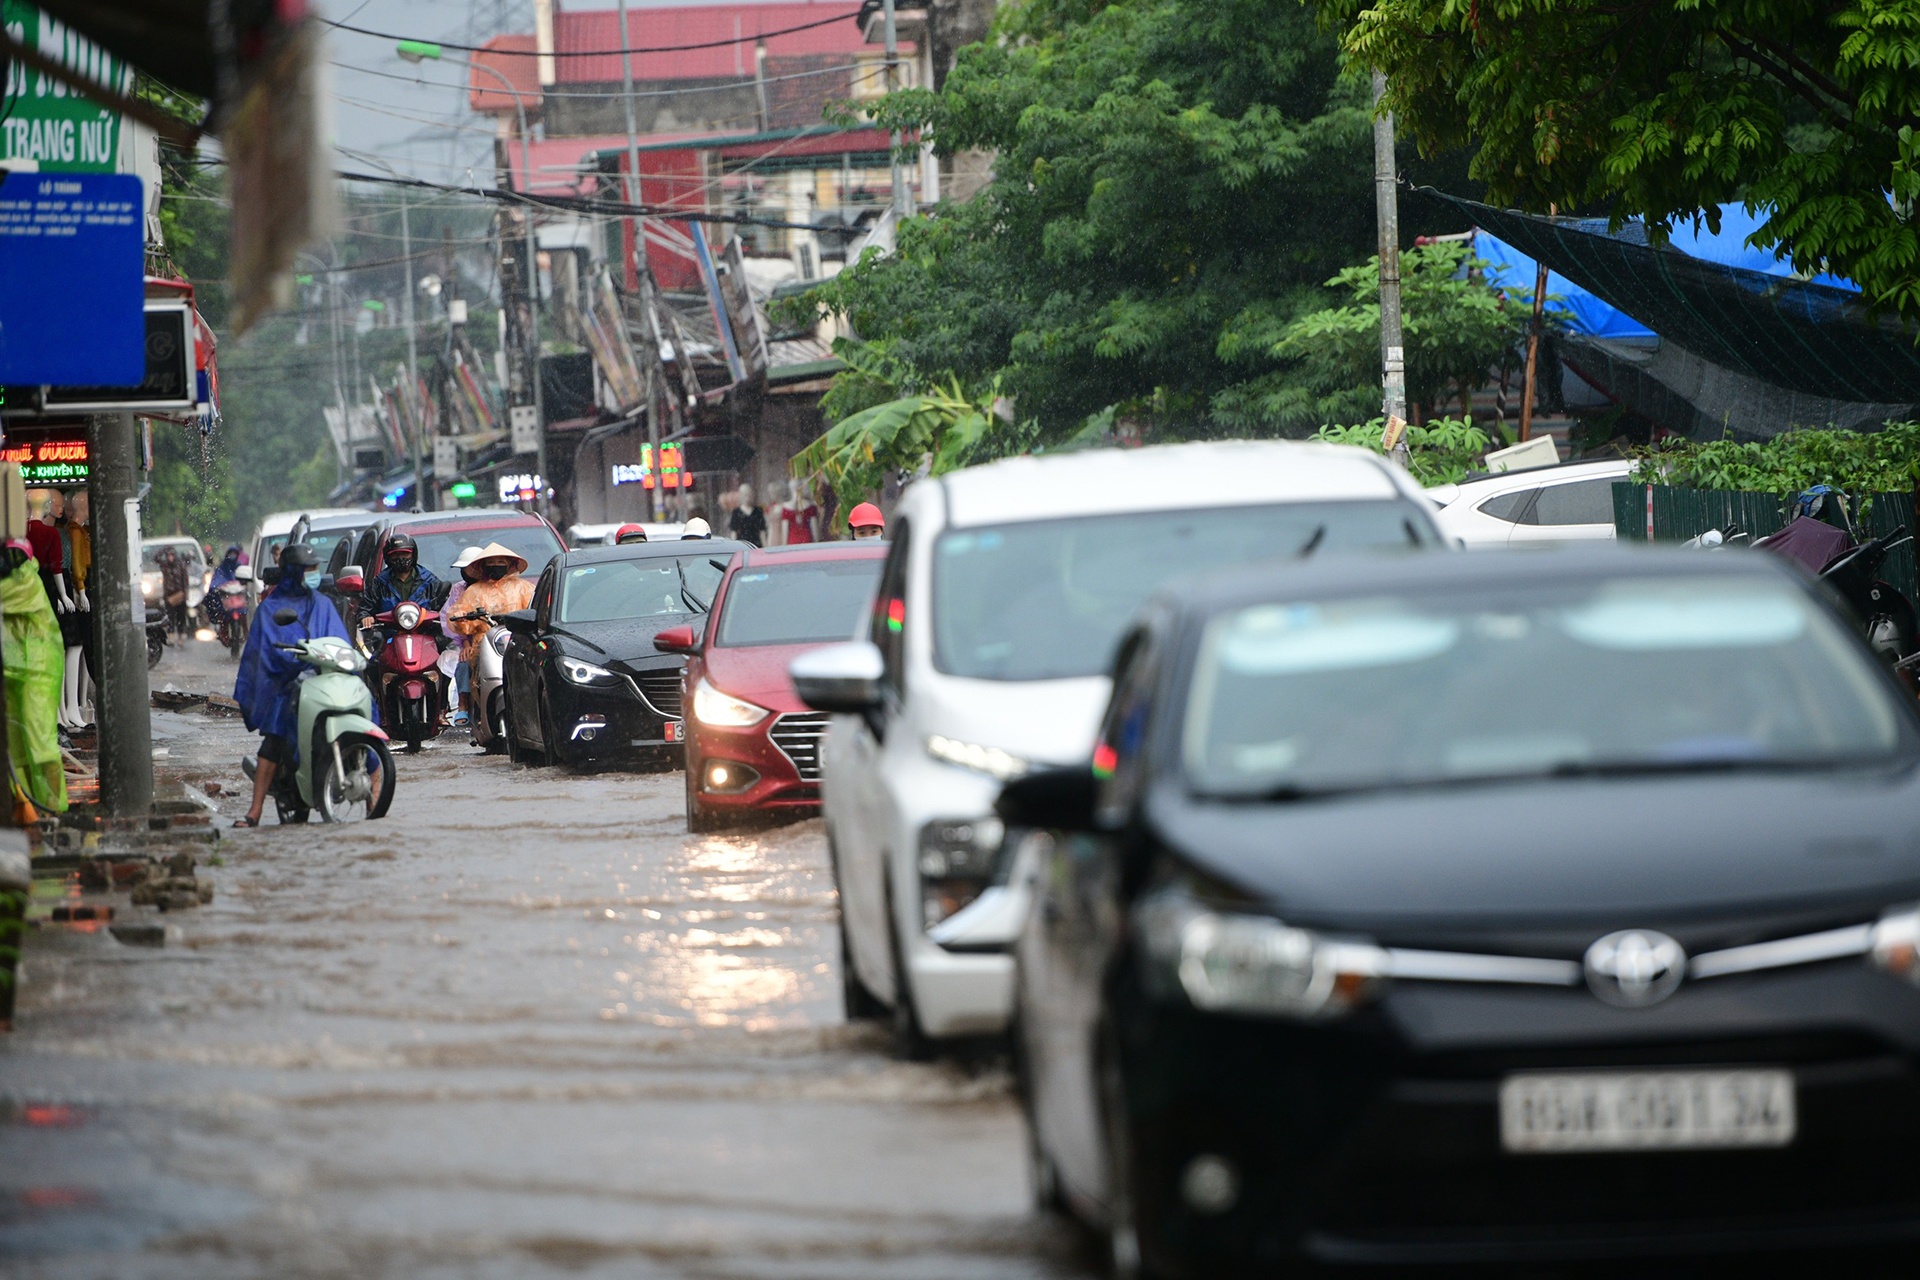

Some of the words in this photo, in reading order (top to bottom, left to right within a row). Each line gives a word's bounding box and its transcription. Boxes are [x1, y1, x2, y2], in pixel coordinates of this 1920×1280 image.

[3, 117, 75, 162] TRANG
[80, 108, 114, 164] NỮ
[37, 463, 73, 476] KHUYÊN
